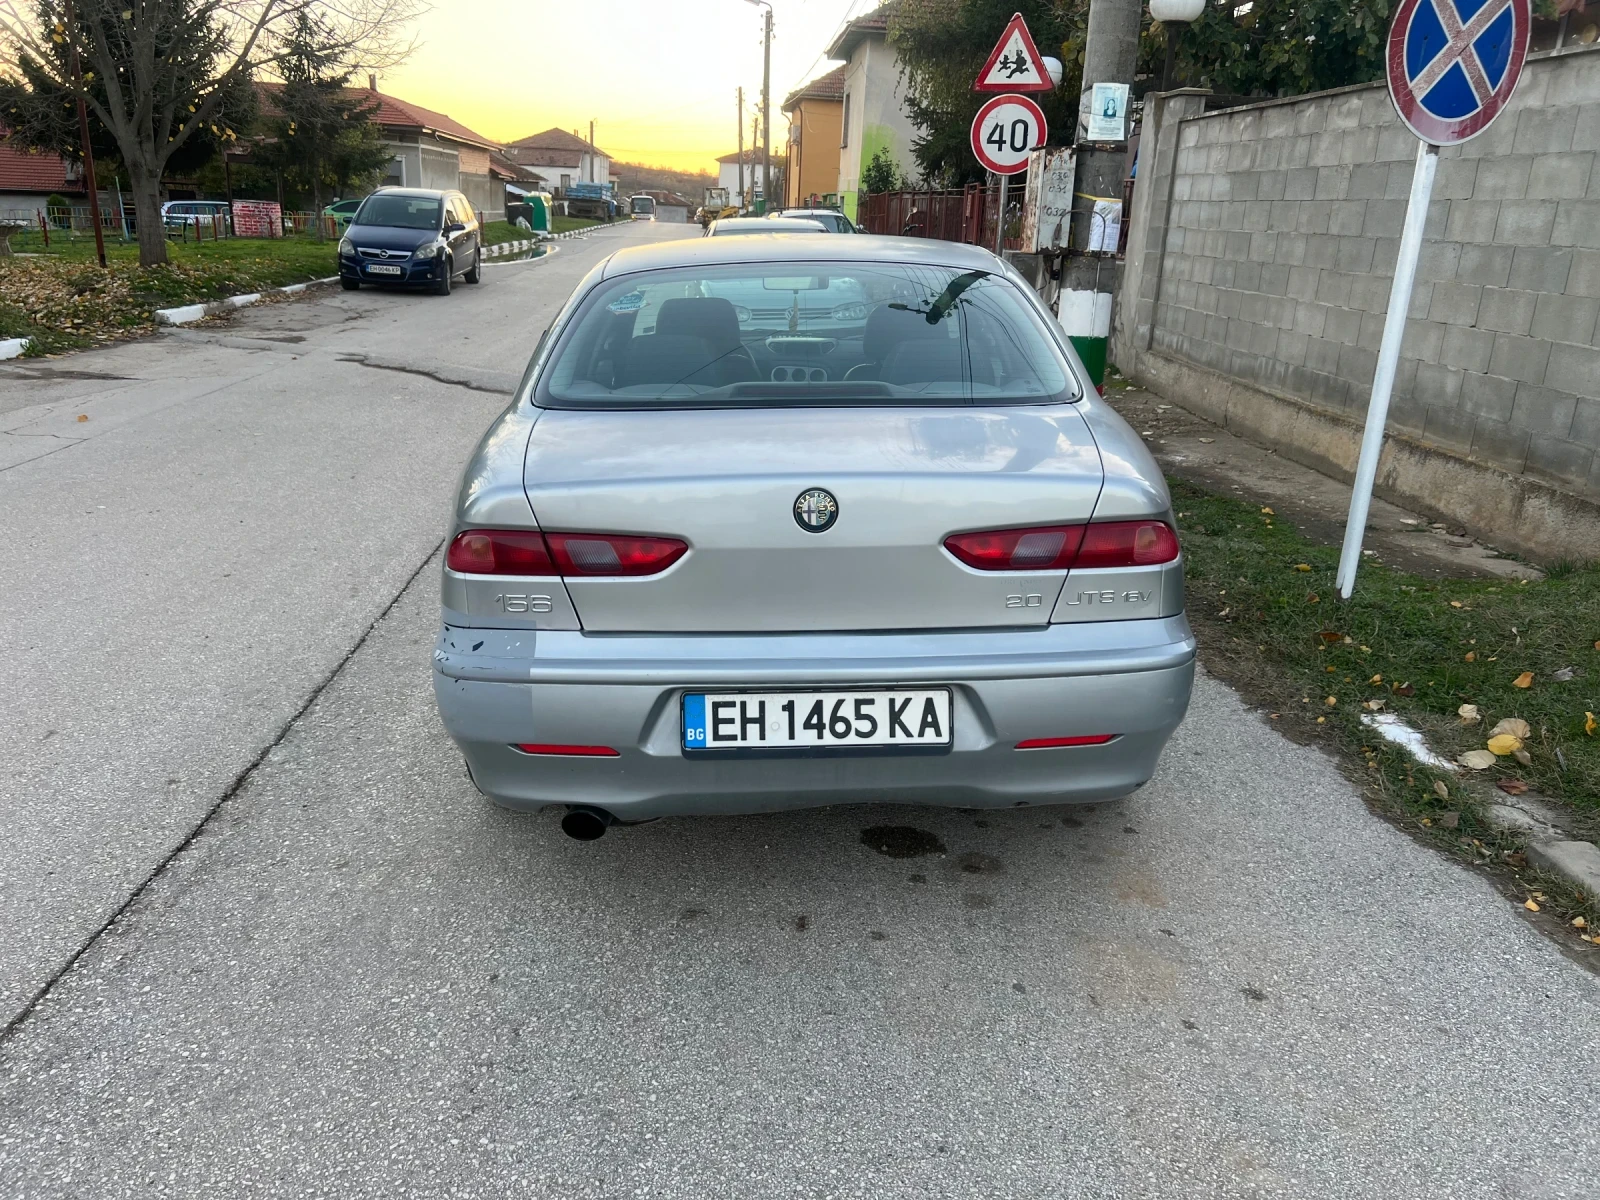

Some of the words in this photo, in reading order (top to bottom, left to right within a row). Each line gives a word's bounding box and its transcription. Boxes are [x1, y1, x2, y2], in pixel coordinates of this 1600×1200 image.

[986, 118, 1029, 153] 40
[1045, 206, 1067, 217] 032
[494, 594, 553, 613] 156
[1005, 593, 1043, 609] 2.0
[1065, 589, 1115, 606] JTS
[711, 700, 766, 742] EH
[781, 698, 878, 740] 1465
[888, 697, 943, 739] KA
[687, 728, 704, 741] BG
